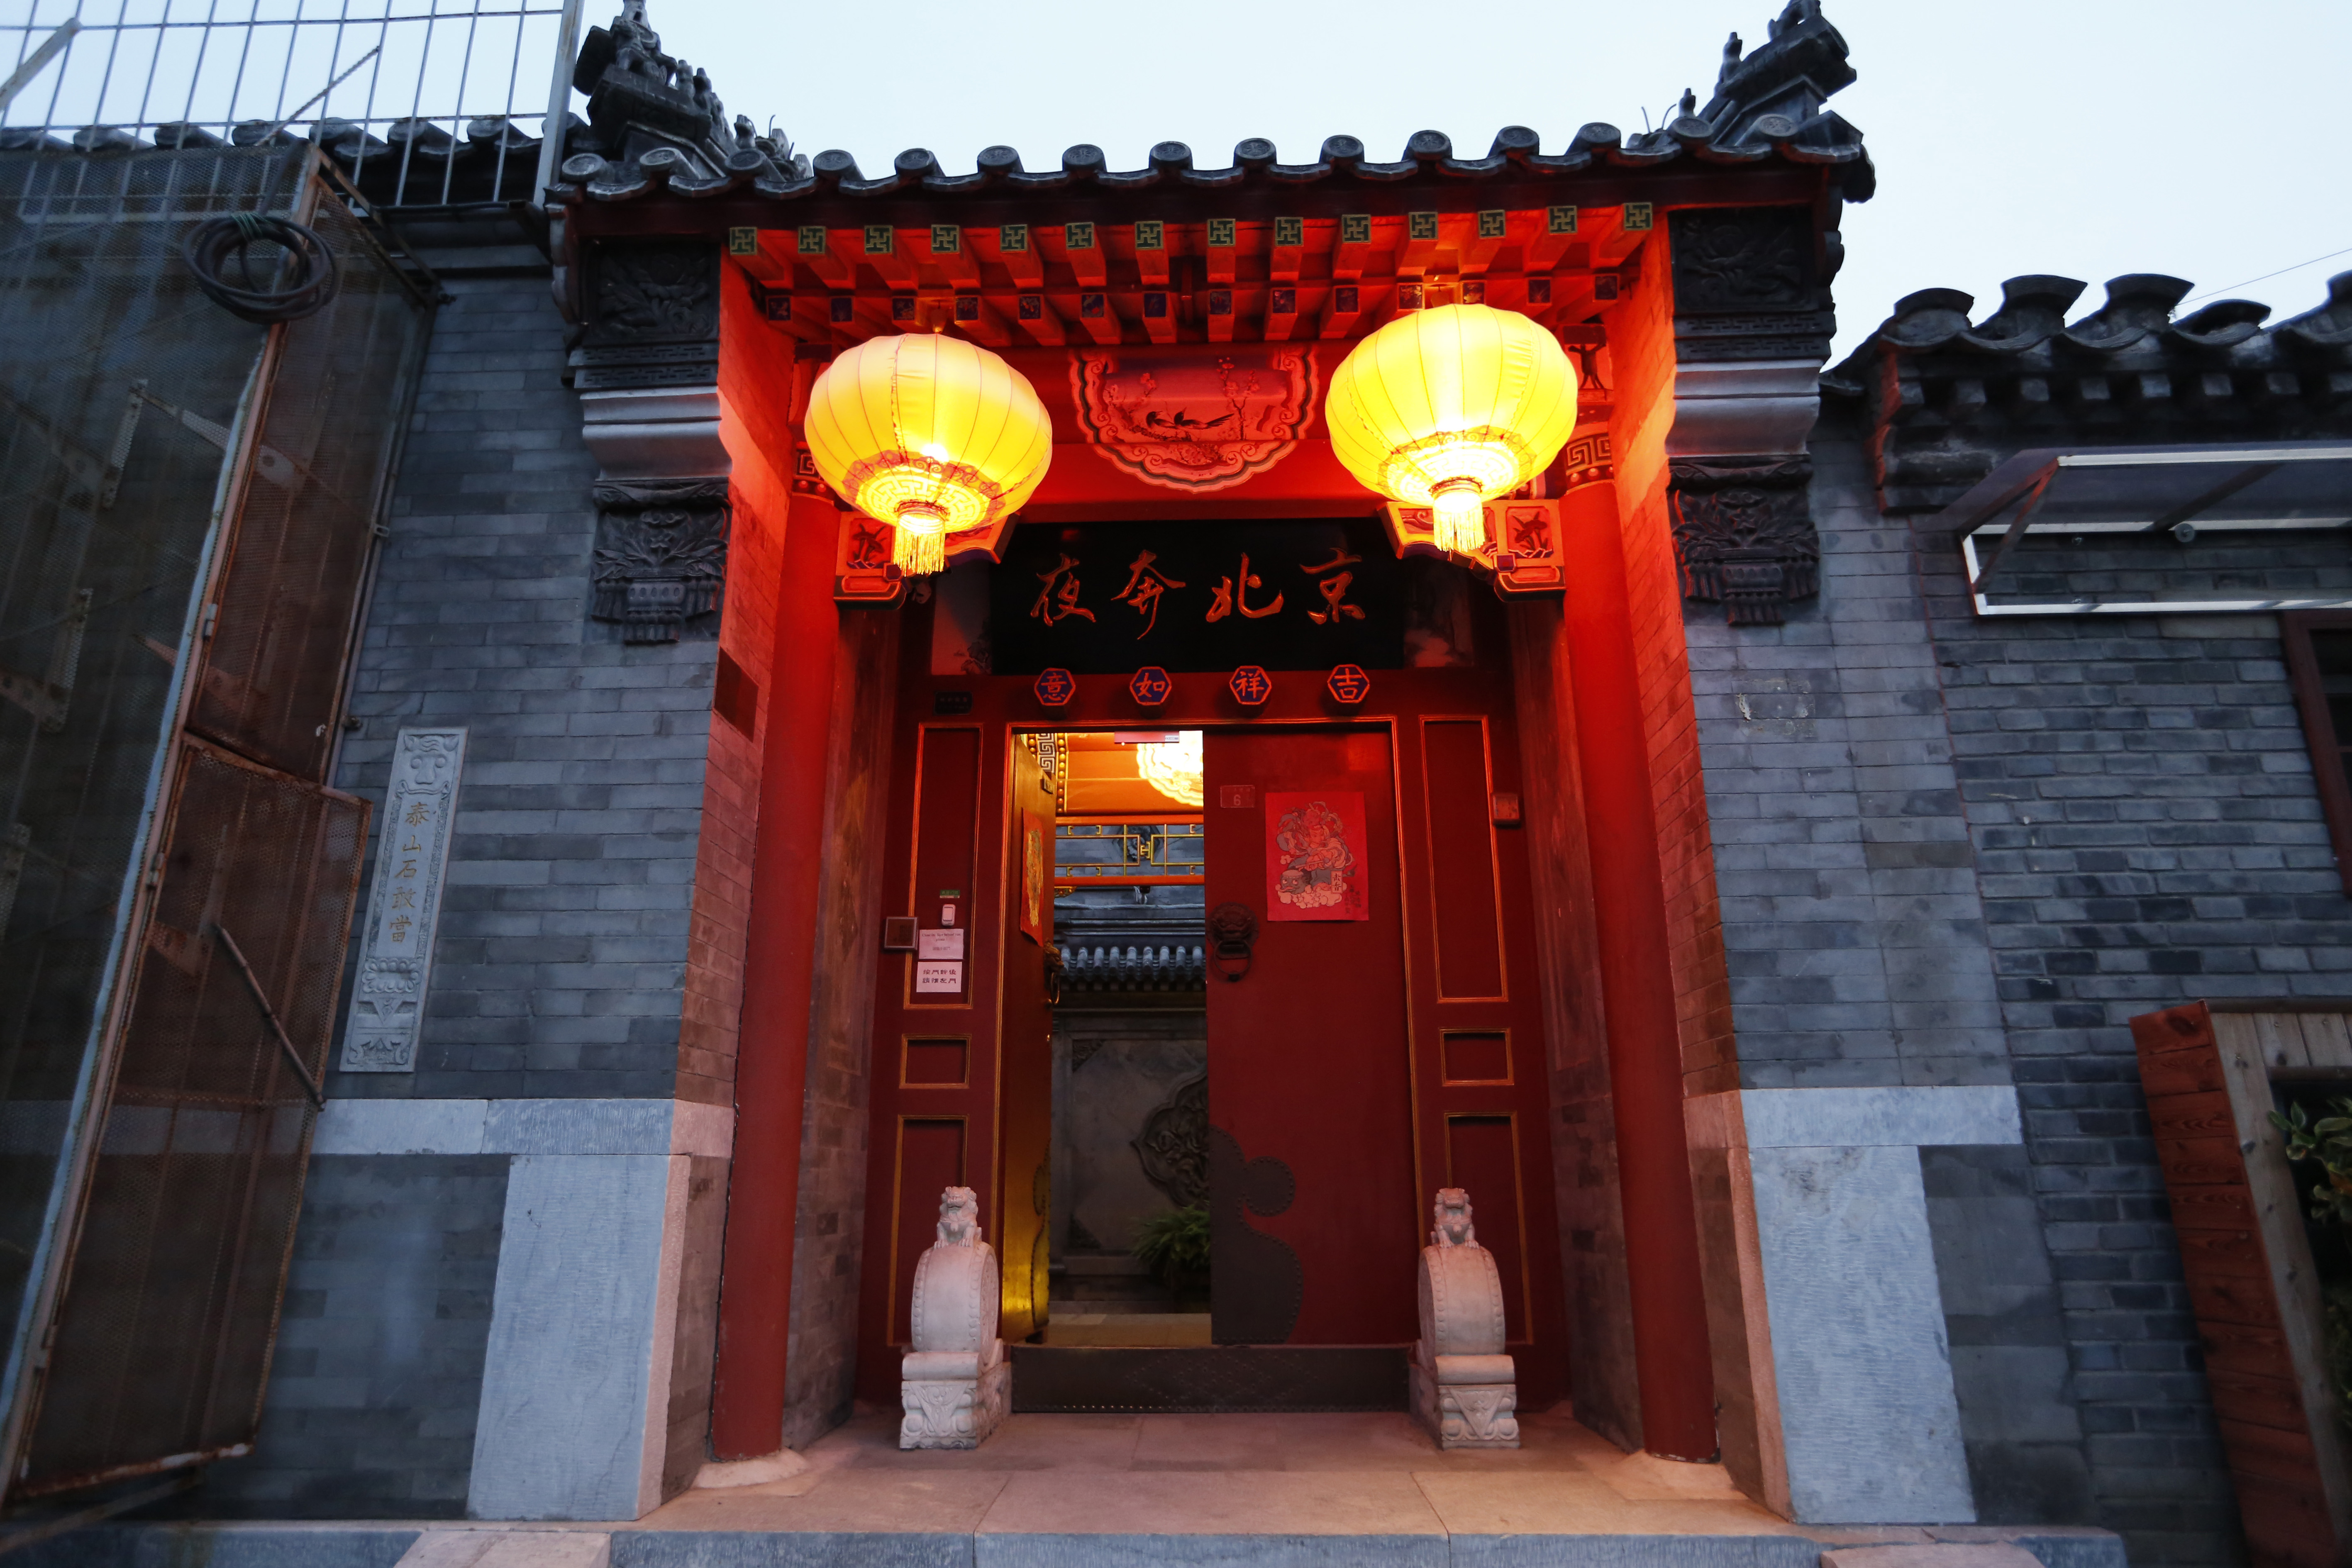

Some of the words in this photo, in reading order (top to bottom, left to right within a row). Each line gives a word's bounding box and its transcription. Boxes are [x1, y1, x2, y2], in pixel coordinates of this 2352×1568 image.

[1234, 794, 1241, 806] 6
[388, 802, 429, 943] 泰山石敢當
